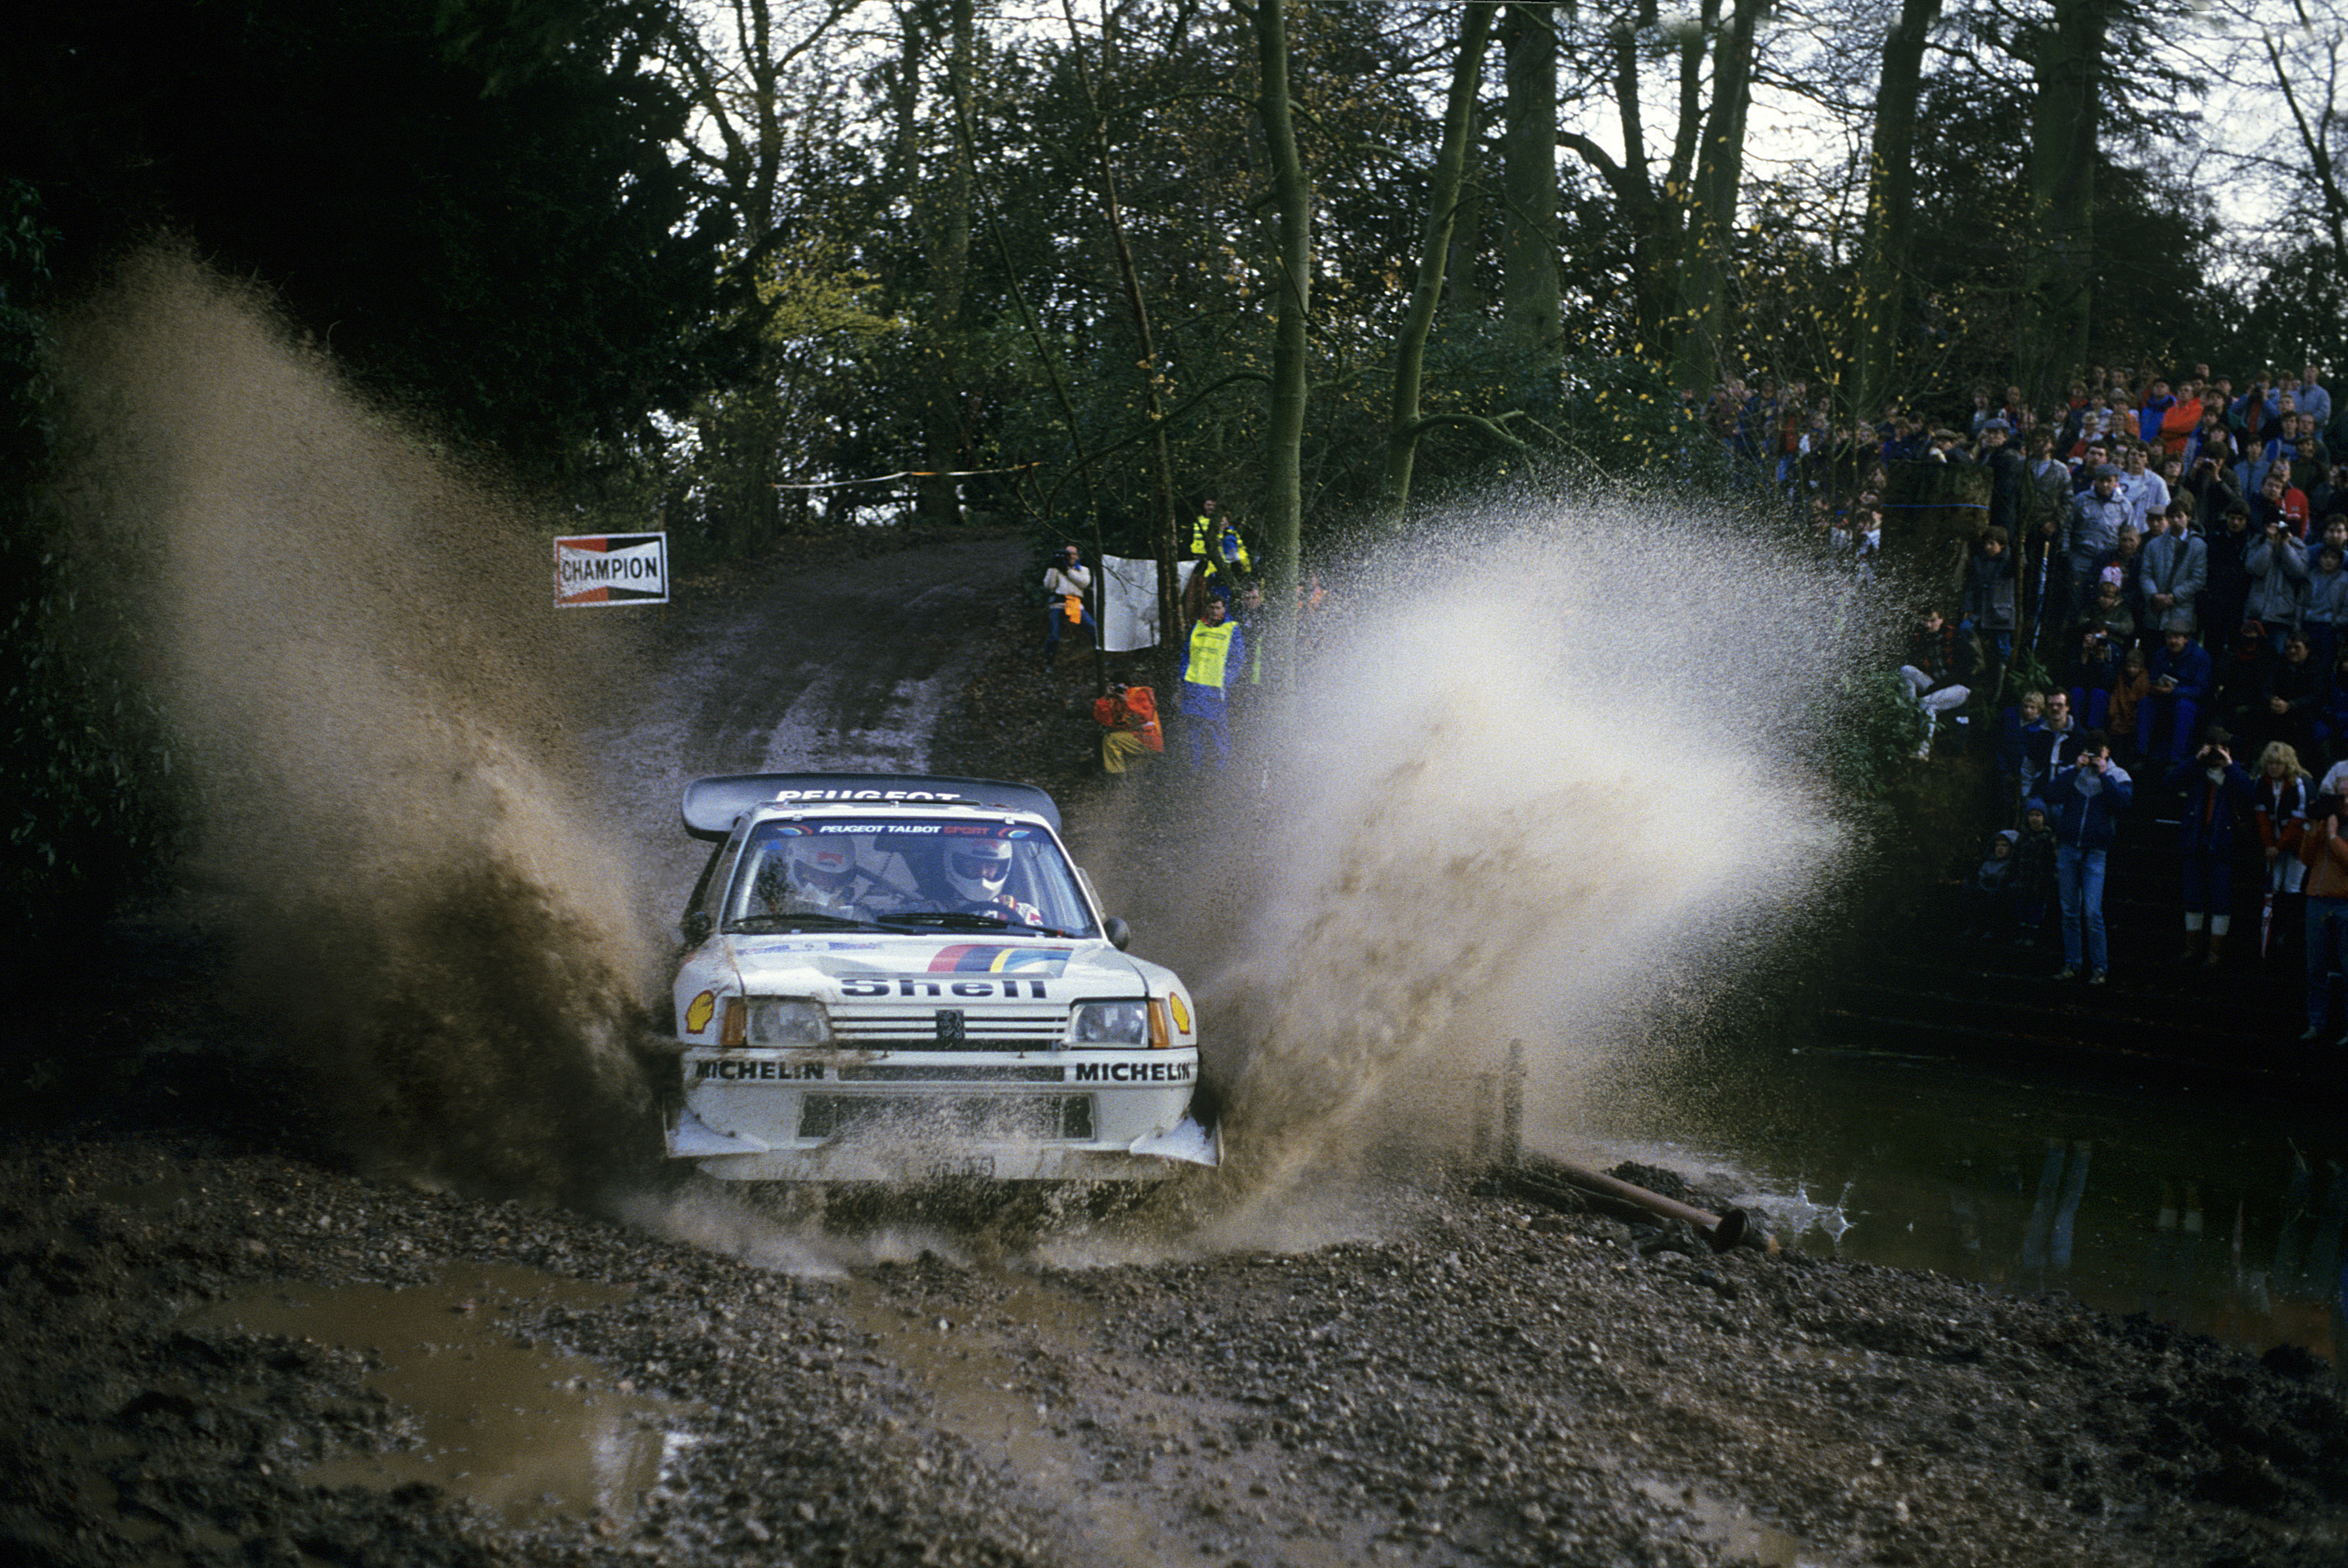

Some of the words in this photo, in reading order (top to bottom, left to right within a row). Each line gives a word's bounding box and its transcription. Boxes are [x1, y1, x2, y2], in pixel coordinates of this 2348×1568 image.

[562, 557, 658, 582] CHAMPION
[944, 826, 990, 834] SPORT
[841, 978, 1047, 999] Shell
[696, 1060, 828, 1080] MICHELIN
[1076, 1061, 1190, 1081] MICHELIN
